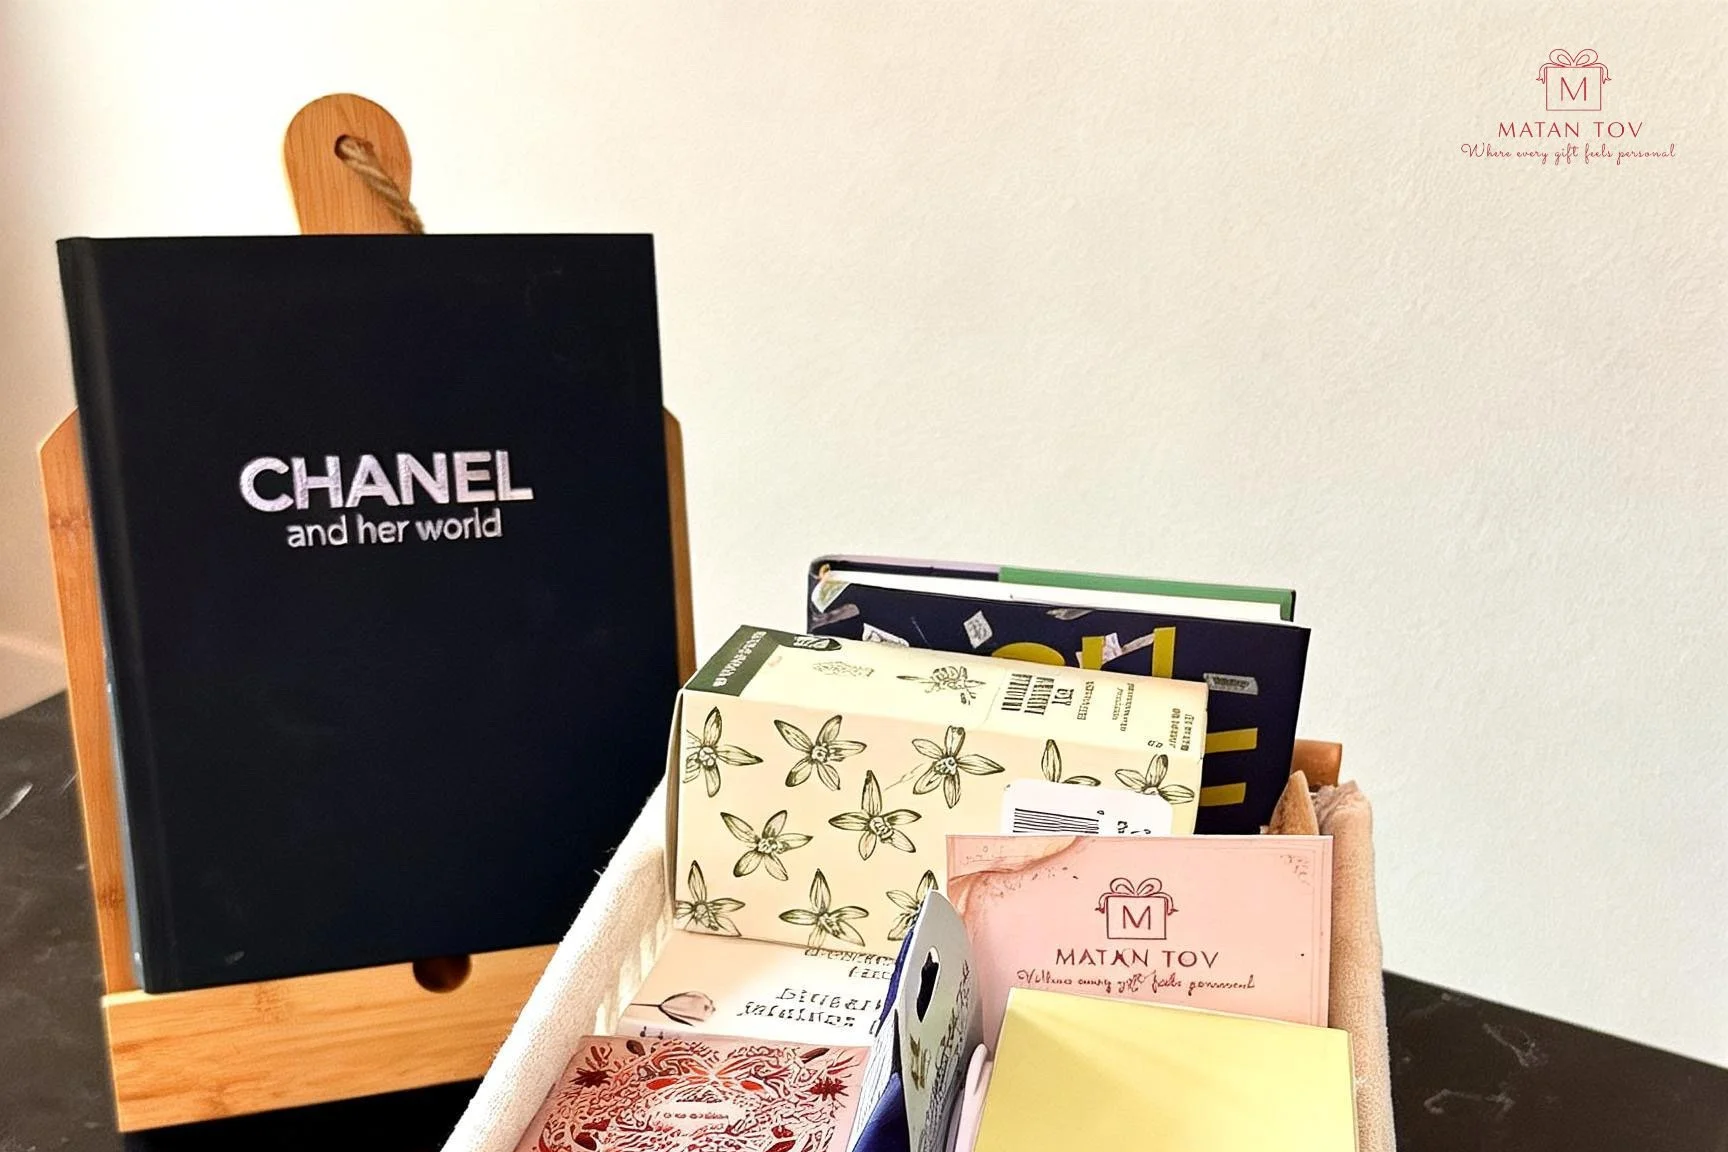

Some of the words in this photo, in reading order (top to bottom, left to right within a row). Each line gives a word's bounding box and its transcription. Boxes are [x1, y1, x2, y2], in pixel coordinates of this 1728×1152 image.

[239, 449, 534, 513] CHANEL
[286, 513, 348, 548] and
[356, 512, 410, 545] her
[415, 506, 503, 541] world
[1122, 904, 1152, 931] M
[1055, 947, 1149, 969] MATAN
[1161, 949, 1219, 969] TOV
